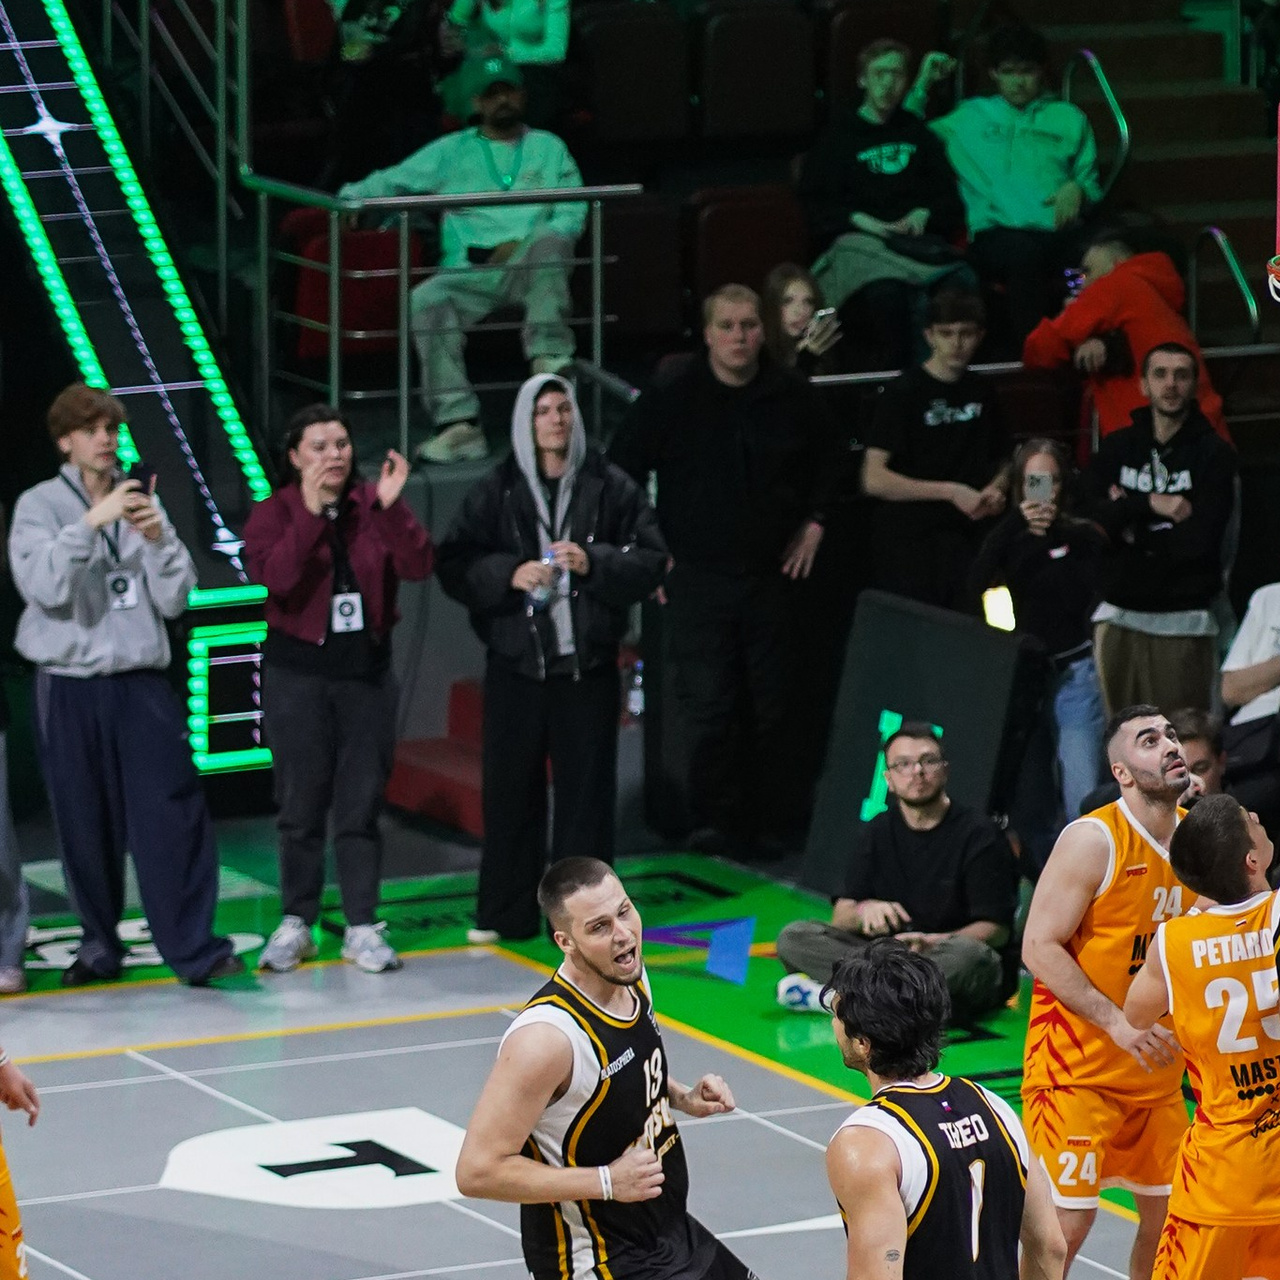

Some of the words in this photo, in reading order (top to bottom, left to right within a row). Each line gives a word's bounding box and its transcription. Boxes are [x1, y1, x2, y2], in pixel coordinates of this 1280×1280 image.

[1152, 886, 1183, 922] 24
[643, 1047, 663, 1108] 13
[1058, 1151, 1097, 1186] 24
[968, 1158, 985, 1263] 1
